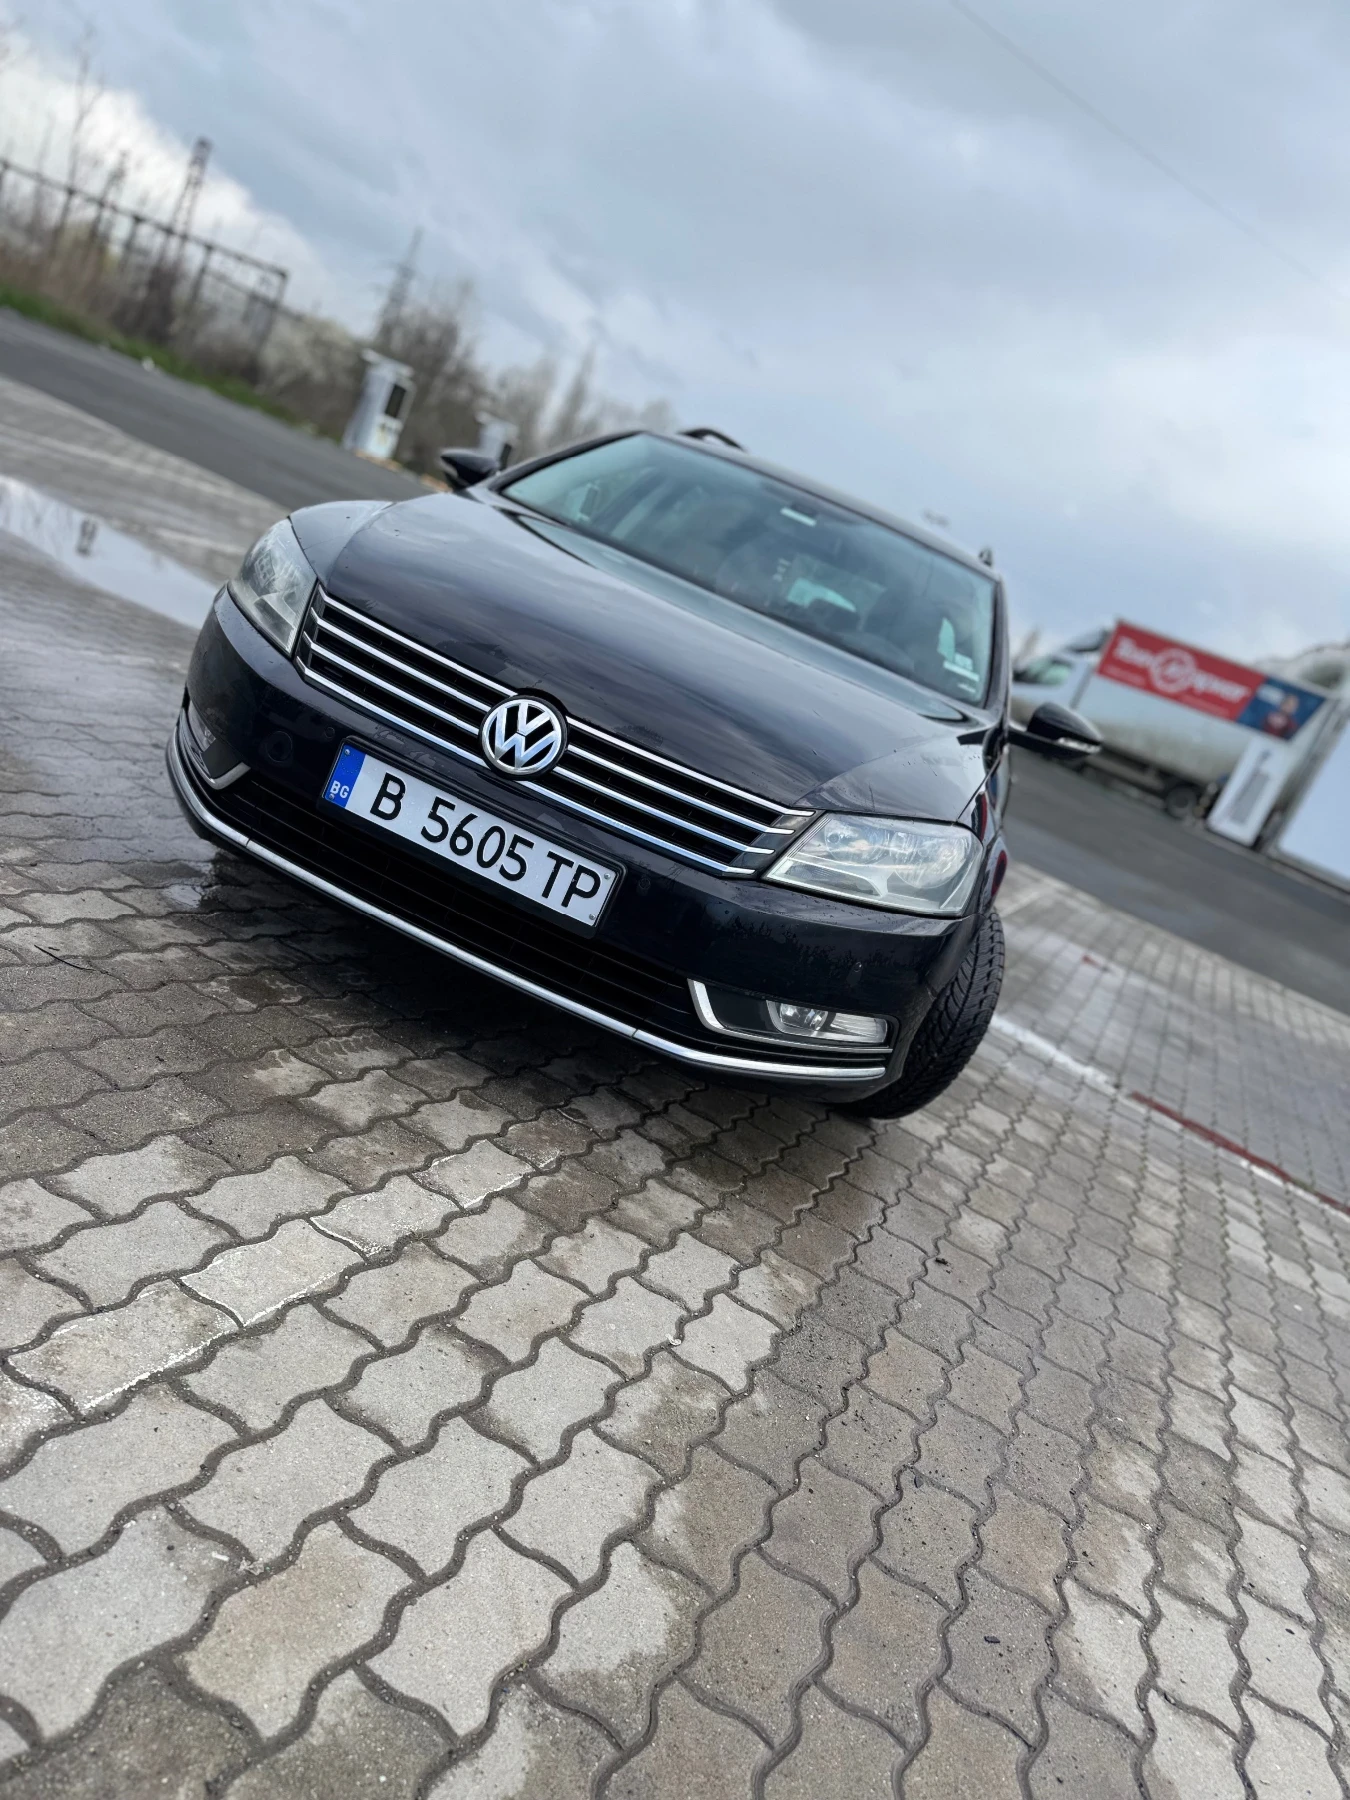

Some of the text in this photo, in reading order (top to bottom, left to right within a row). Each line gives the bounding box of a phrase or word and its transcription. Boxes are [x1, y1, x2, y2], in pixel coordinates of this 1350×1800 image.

[492, 701, 559, 770] VW
[330, 780, 350, 799] BG
[369, 772, 601, 908] B 5605 TP
